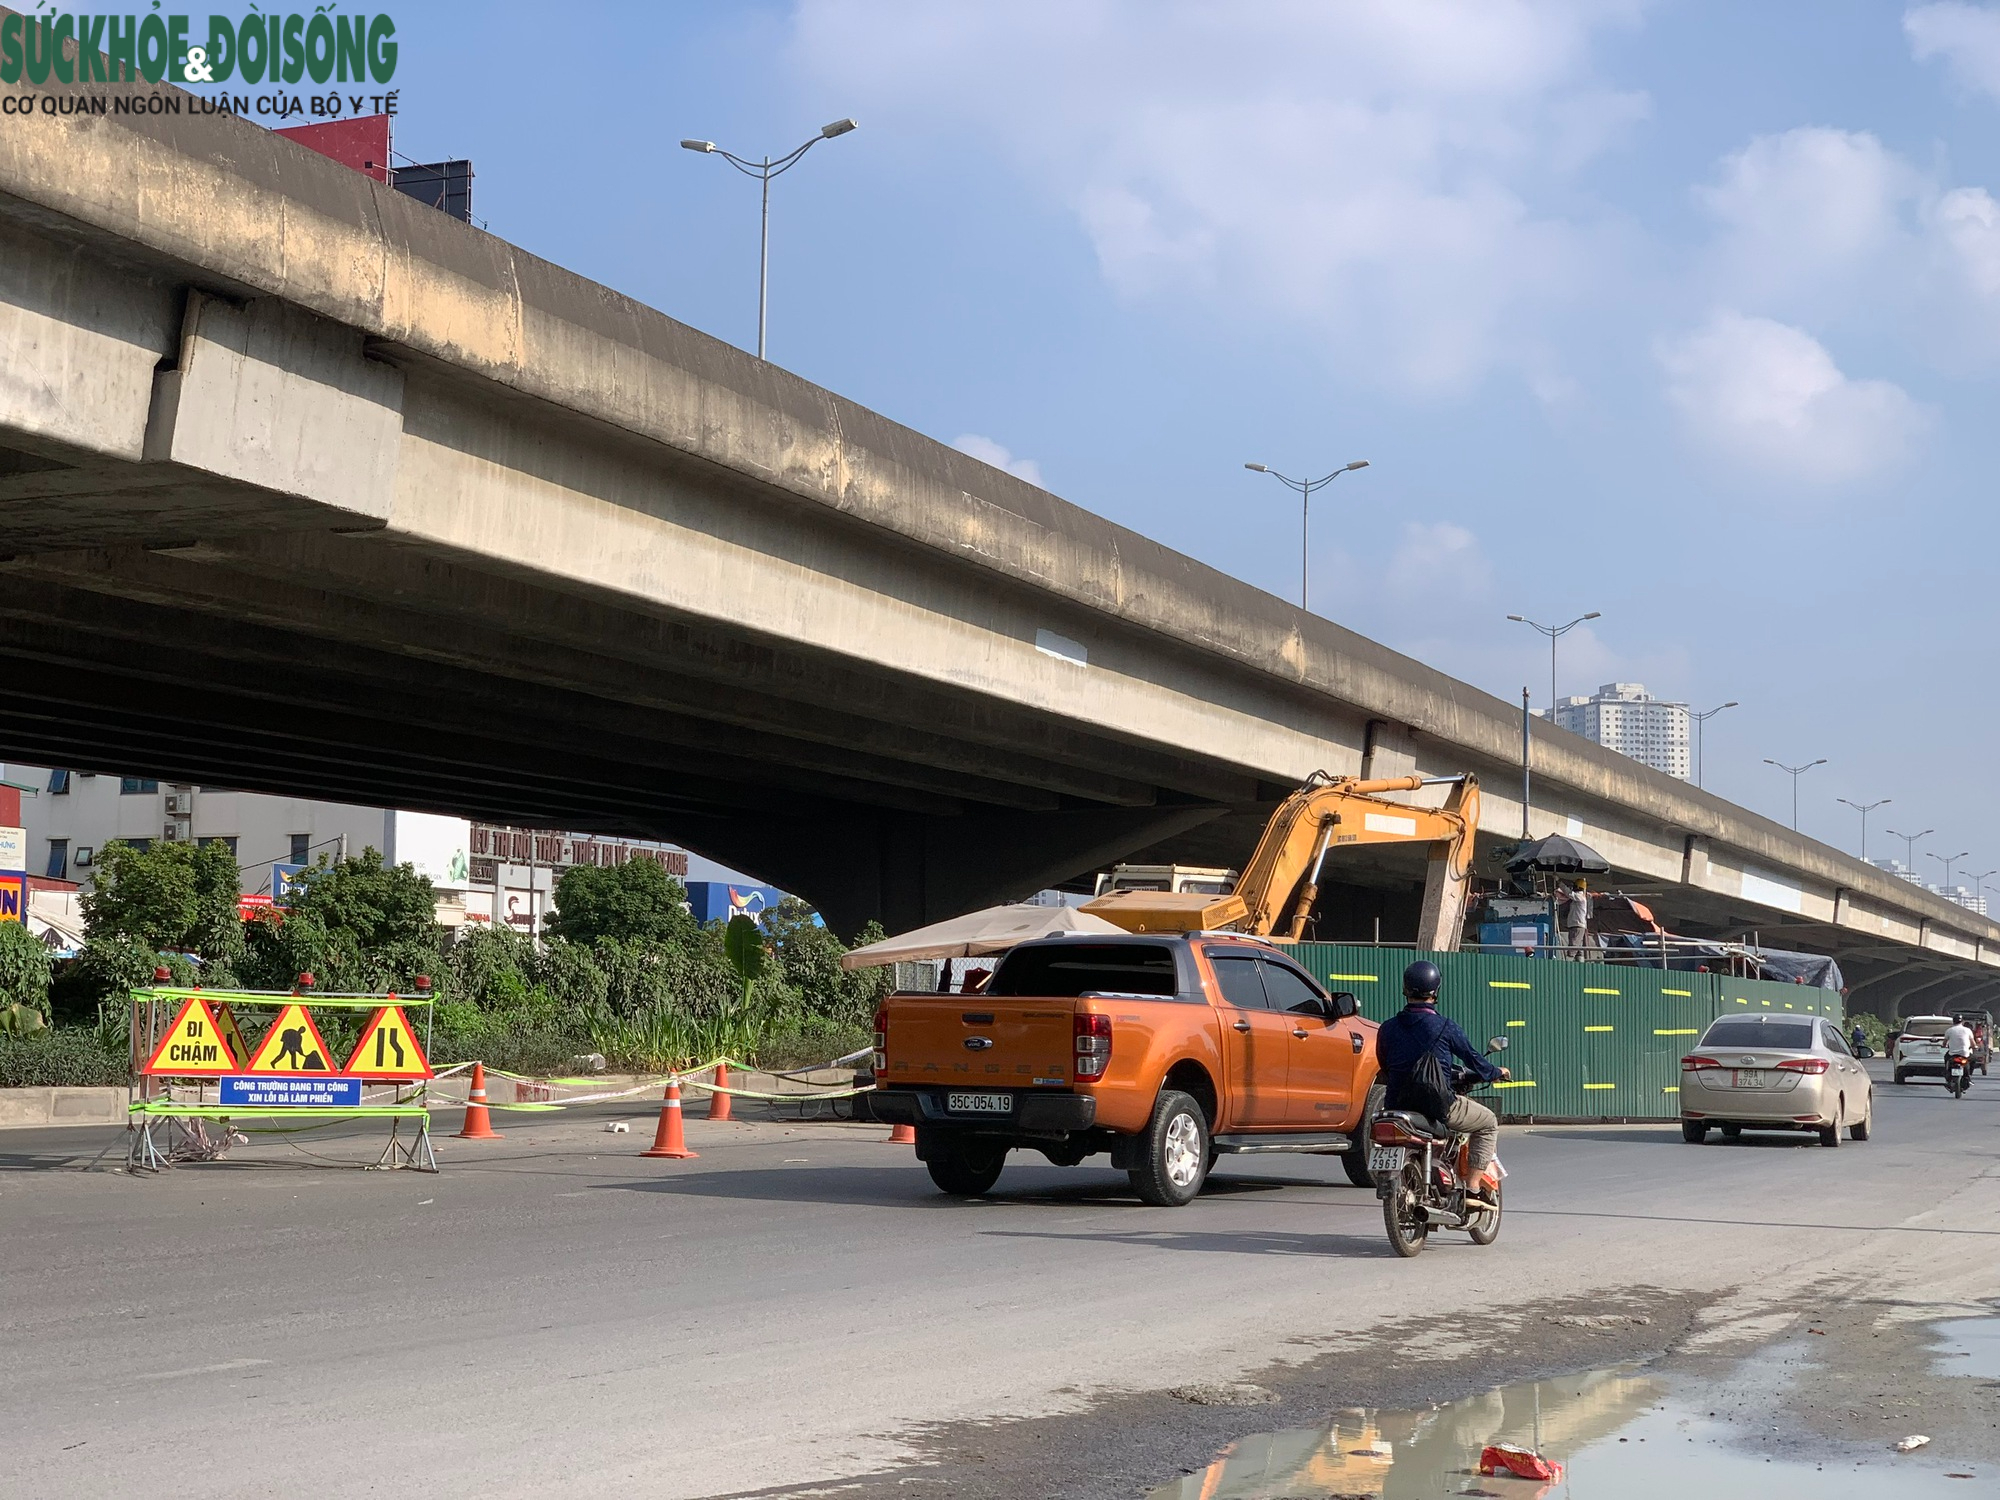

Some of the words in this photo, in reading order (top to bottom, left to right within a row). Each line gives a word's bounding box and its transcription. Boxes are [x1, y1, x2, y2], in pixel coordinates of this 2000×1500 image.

[187, 1021, 203, 1037] ĐI
[170, 1041, 217, 1065] CHẬM
[1743, 1069, 1758, 1079] 99A
[233, 1080, 255, 1090] CÔNG
[257, 1080, 288, 1091] TRƯỜNG
[290, 1082, 311, 1091] ĐANG
[313, 1083, 325, 1091] THI
[327, 1081, 348, 1092] CÔNG
[248, 1093, 262, 1102] XIN
[264, 1091, 277, 1102] LỖI
[278, 1092, 289, 1102] ĐÃ
[290, 1093, 308, 1102] LÀM
[950, 1095, 1010, 1111] 35C-054.19
[1373, 1148, 1398, 1159] 72-L4
[1372, 1159, 1397, 1170] 2963
